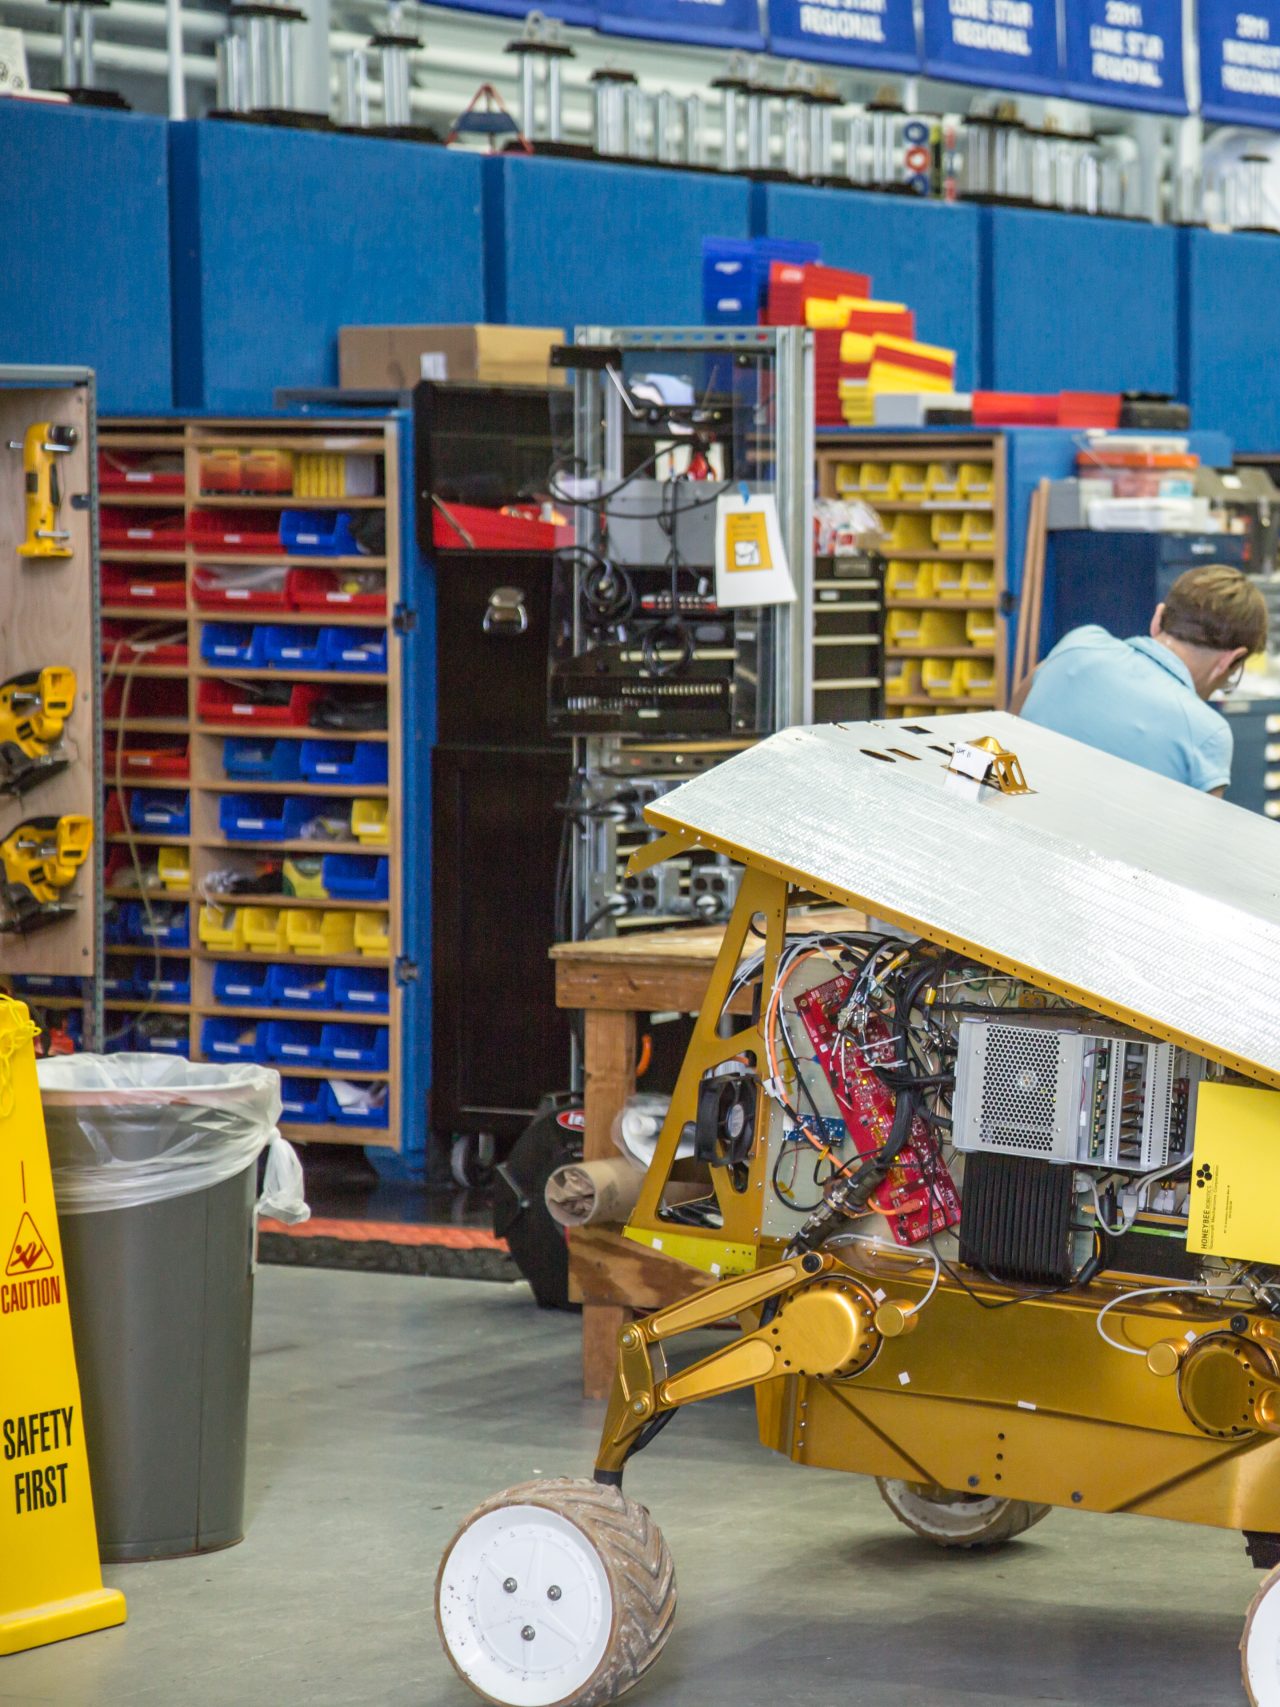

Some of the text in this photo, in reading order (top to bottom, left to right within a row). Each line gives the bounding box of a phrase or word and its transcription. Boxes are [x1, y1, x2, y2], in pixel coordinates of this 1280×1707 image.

[799, 5, 886, 43] REGIONAL
[990, 1, 1033, 29] STAR
[952, 18, 1032, 56] REGIONAL
[1090, 24, 1164, 61] LONE STAR
[1092, 52, 1163, 88] REGIONAL
[1201, 1209, 1210, 1250] HONEYBEE
[0, 1275, 61, 1314] CAUTION
[3, 1406, 73, 1461] SAFETY
[14, 1462, 69, 1515] FIRST
